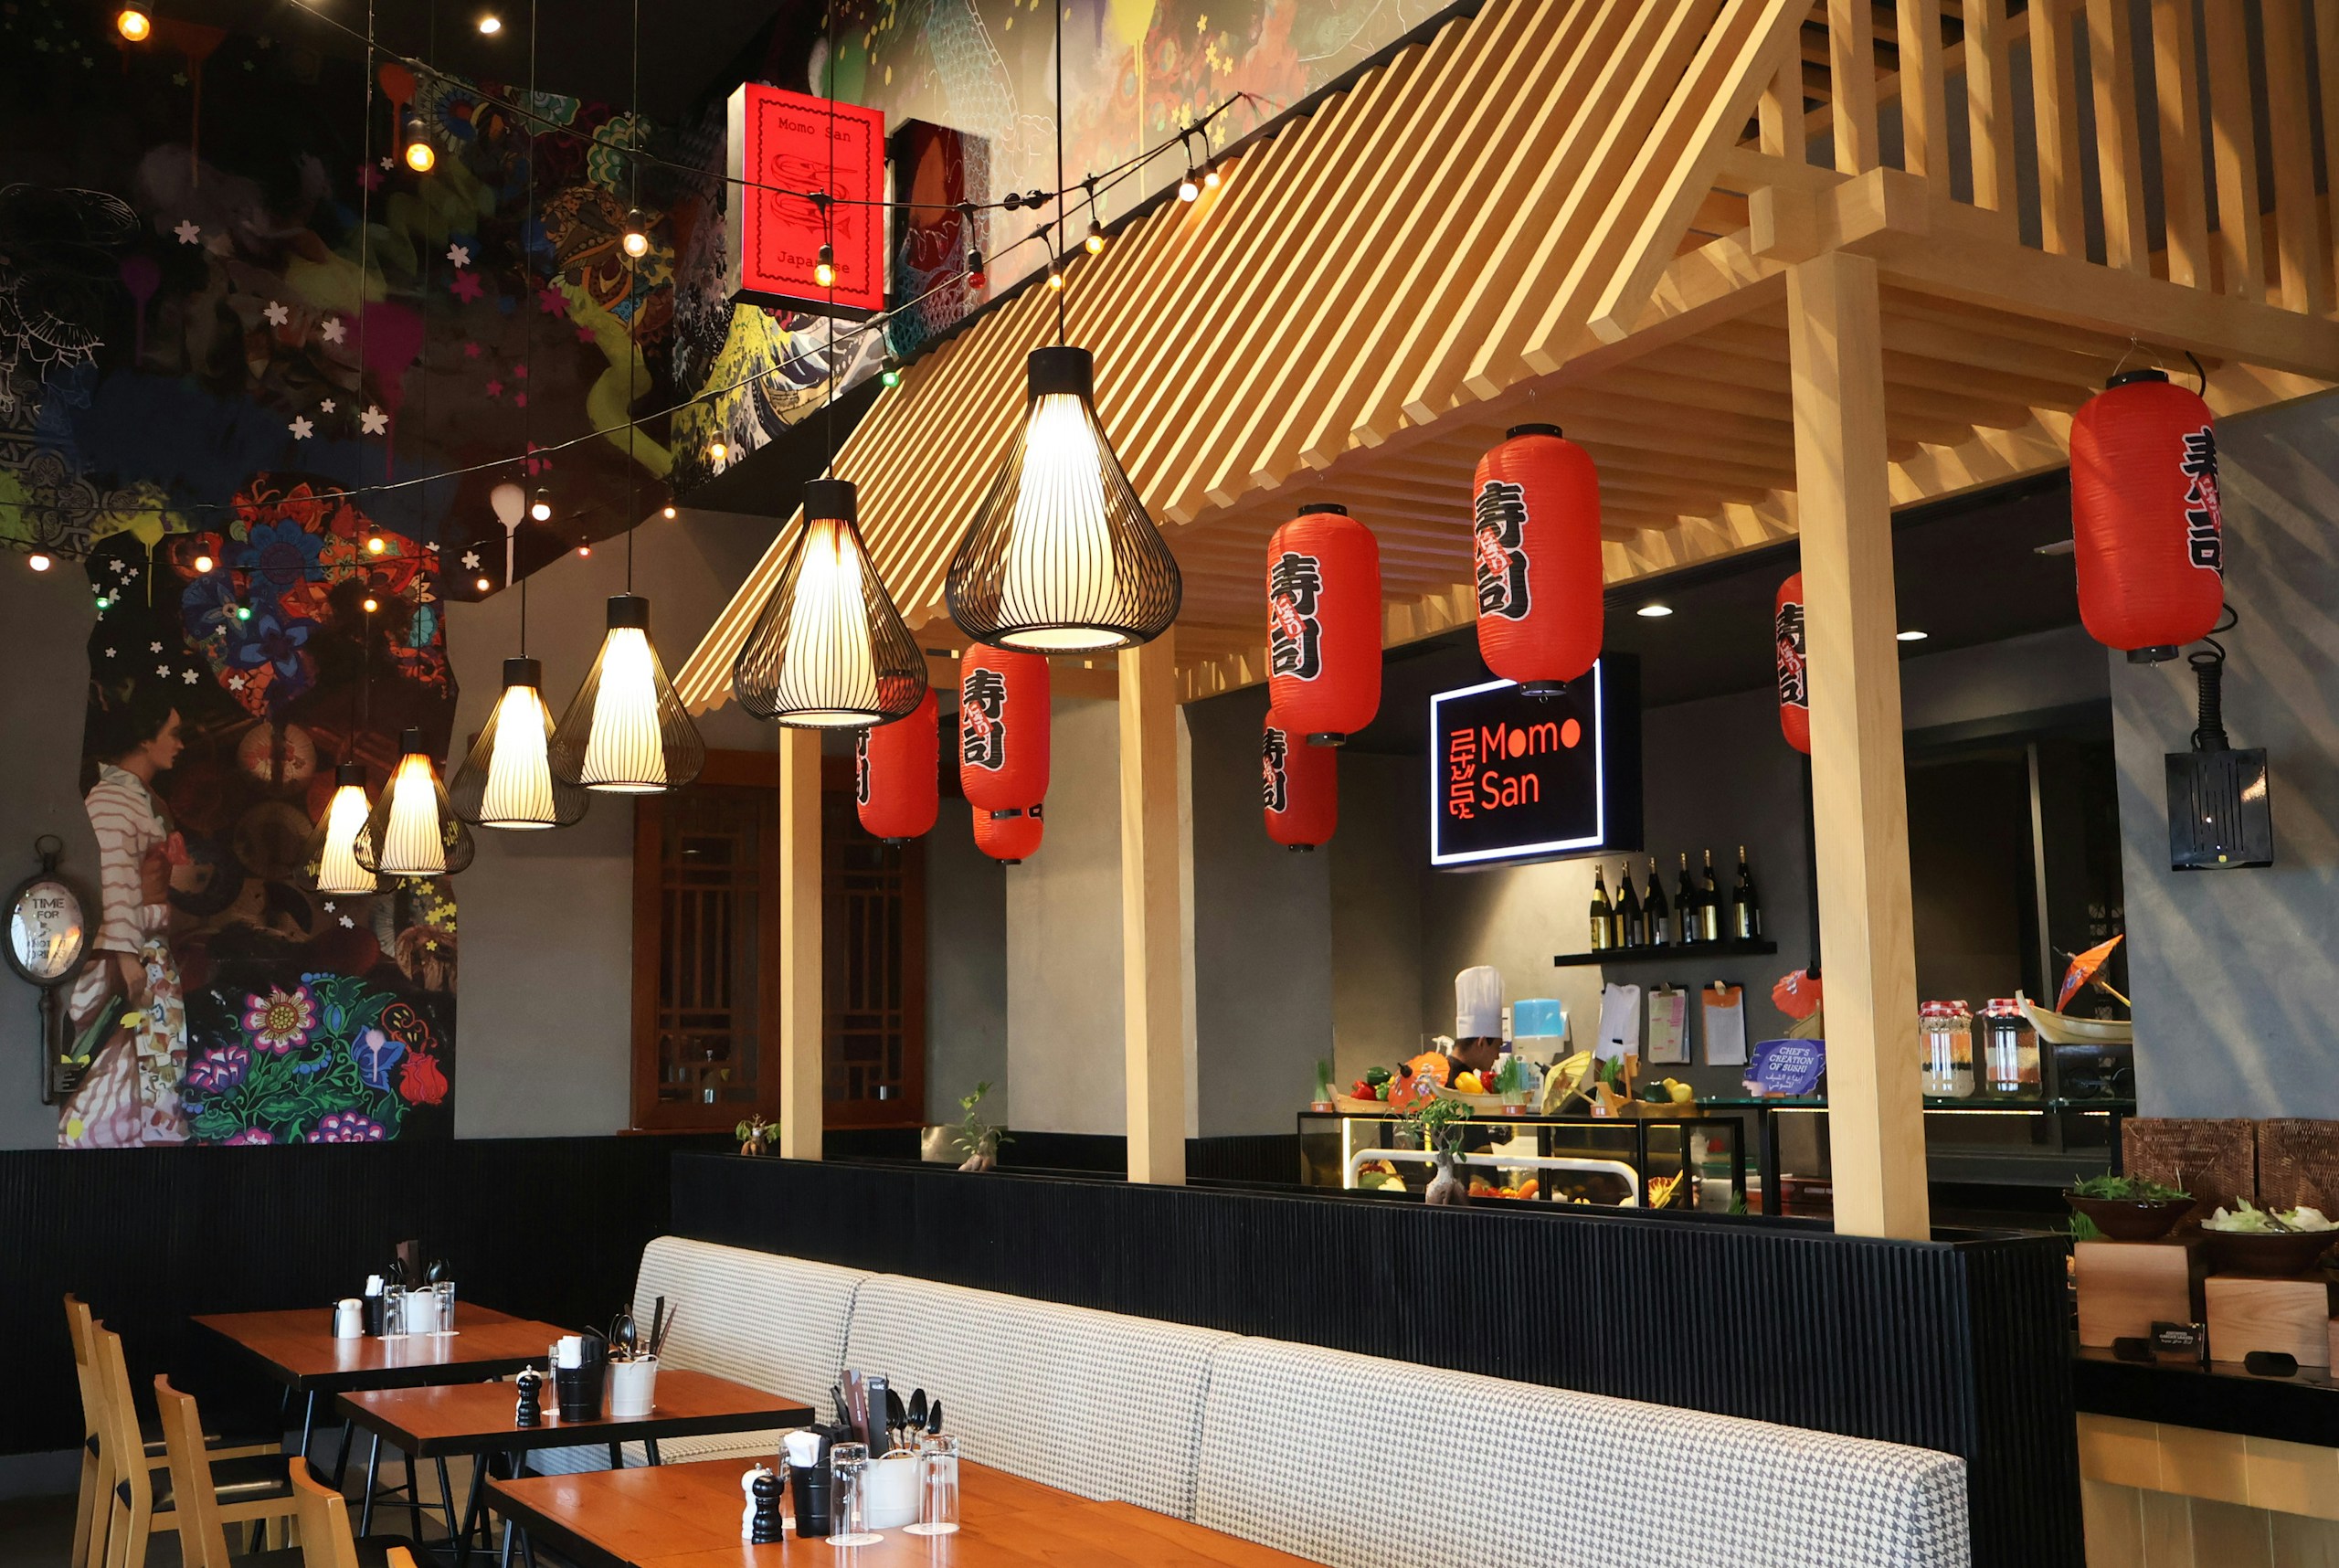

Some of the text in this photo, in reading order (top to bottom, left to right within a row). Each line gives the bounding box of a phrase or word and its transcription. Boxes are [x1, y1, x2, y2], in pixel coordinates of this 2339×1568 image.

[778, 117, 851, 143] Momo San
[778, 250, 850, 274] Japase
[1474, 479, 1532, 621] 寿司
[1269, 551, 1324, 682] 寿司
[963, 668, 1008, 772] 寿司
[1481, 718, 1582, 764] Momo
[1481, 770, 1540, 810] San
[33, 898, 65, 909] TIME
[37, 910, 59, 919] FOR
[1770, 1054, 1814, 1065] CREATION
[1780, 1047, 1810, 1056] CHEF'S
[1782, 1064, 1807, 1073] SUSHI
